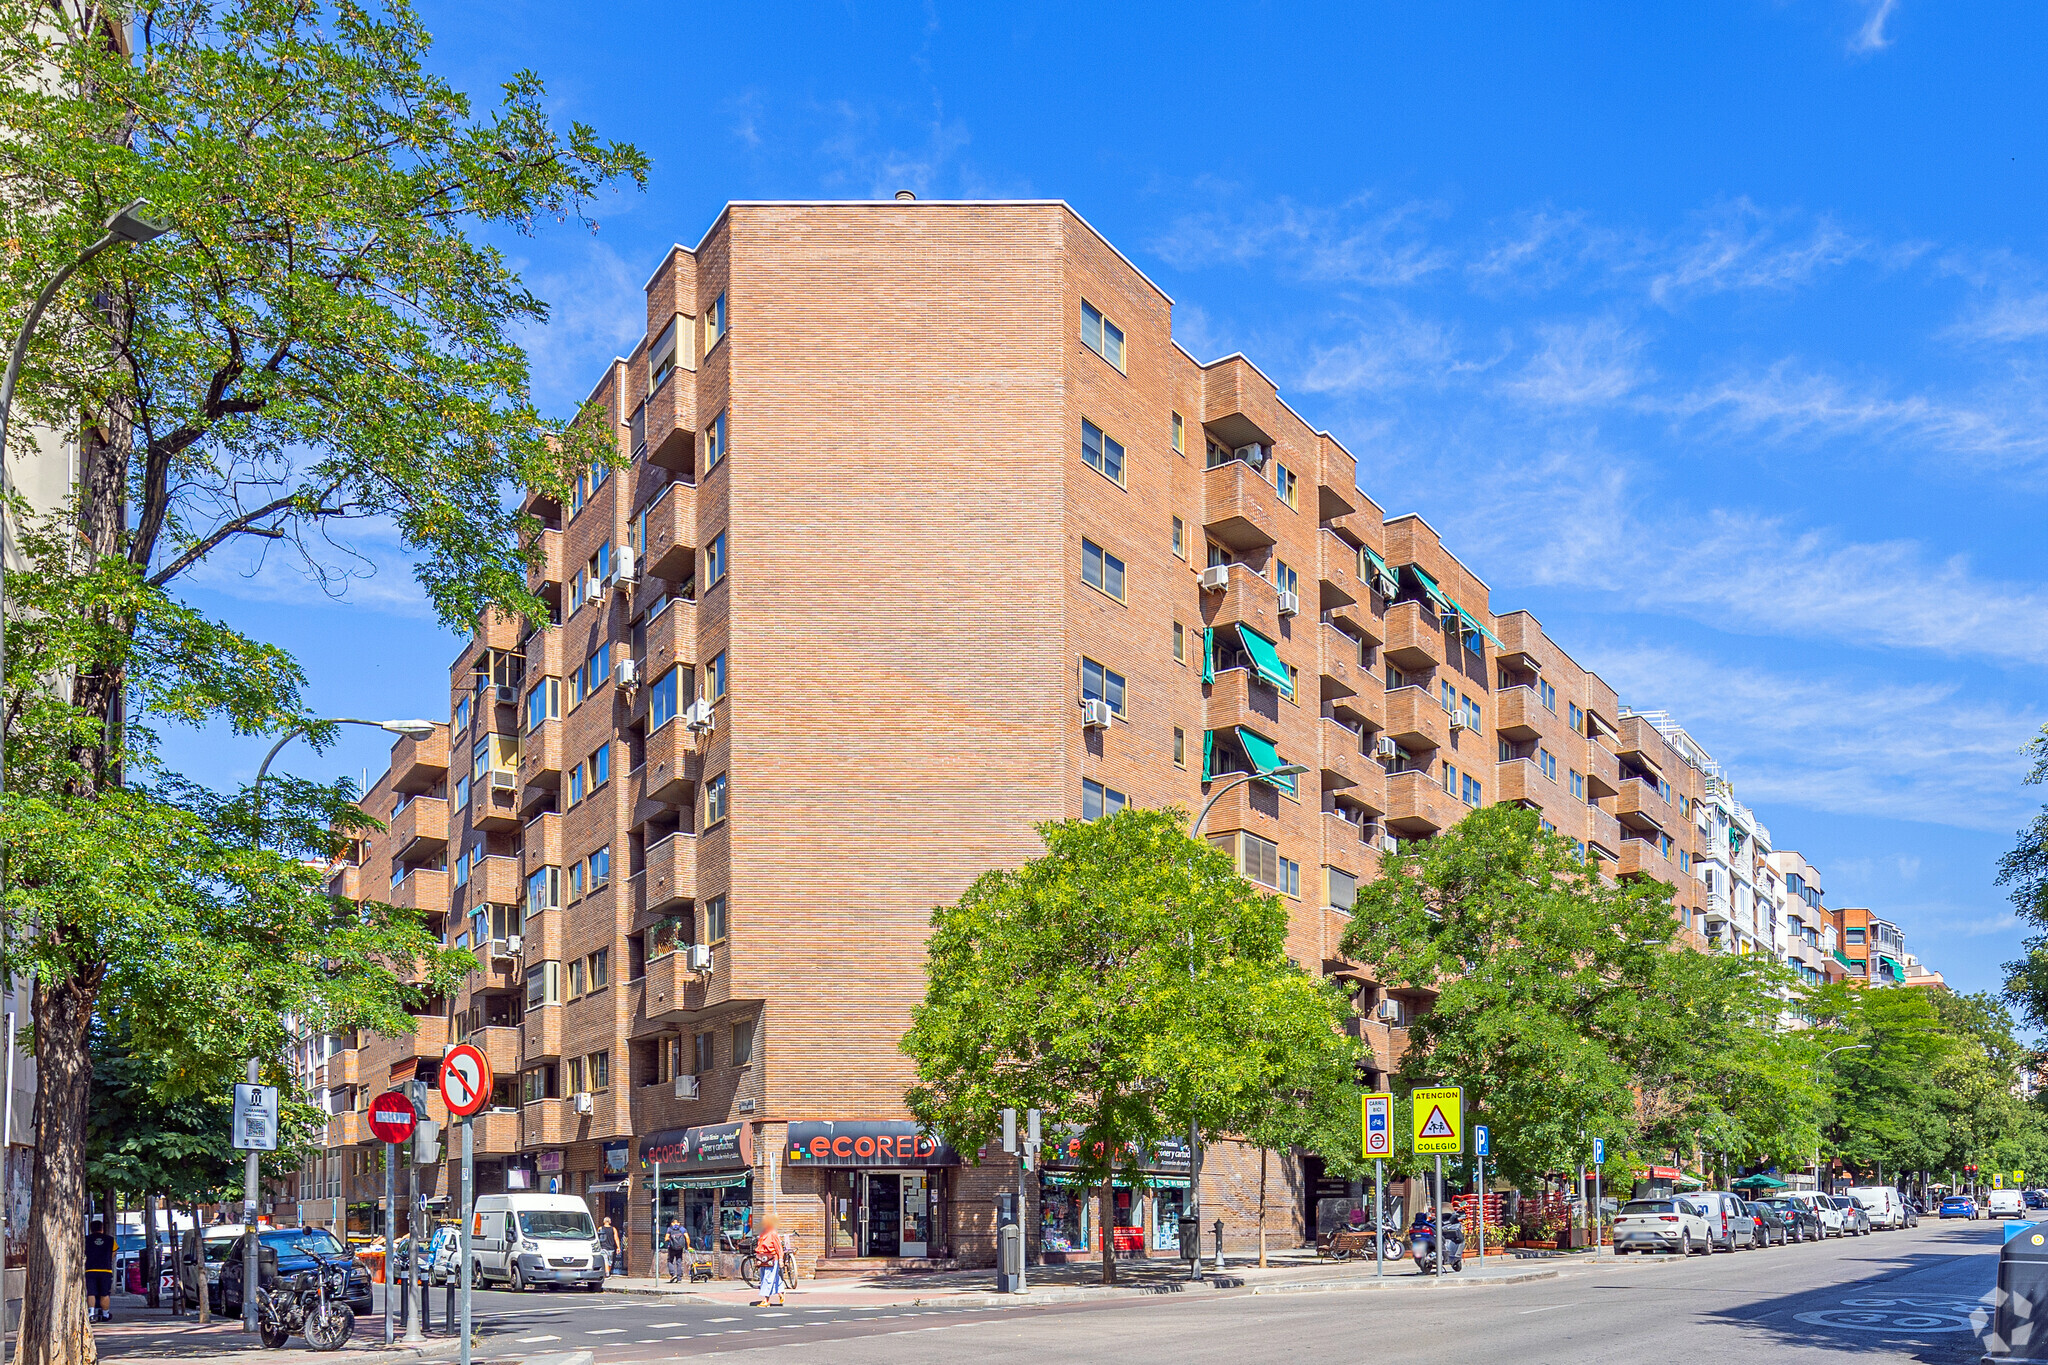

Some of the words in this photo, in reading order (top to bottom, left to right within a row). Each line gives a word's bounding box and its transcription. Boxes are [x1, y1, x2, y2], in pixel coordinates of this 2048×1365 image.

[1415, 1091, 1458, 1100] ATENCION
[809, 1135, 936, 1158] ecoRED
[1417, 1142, 1457, 1151] COLEGIO
[1479, 1129, 1486, 1152] P
[648, 1143, 689, 1165] ecoRED
[1837, 1313, 1942, 1327] 30
